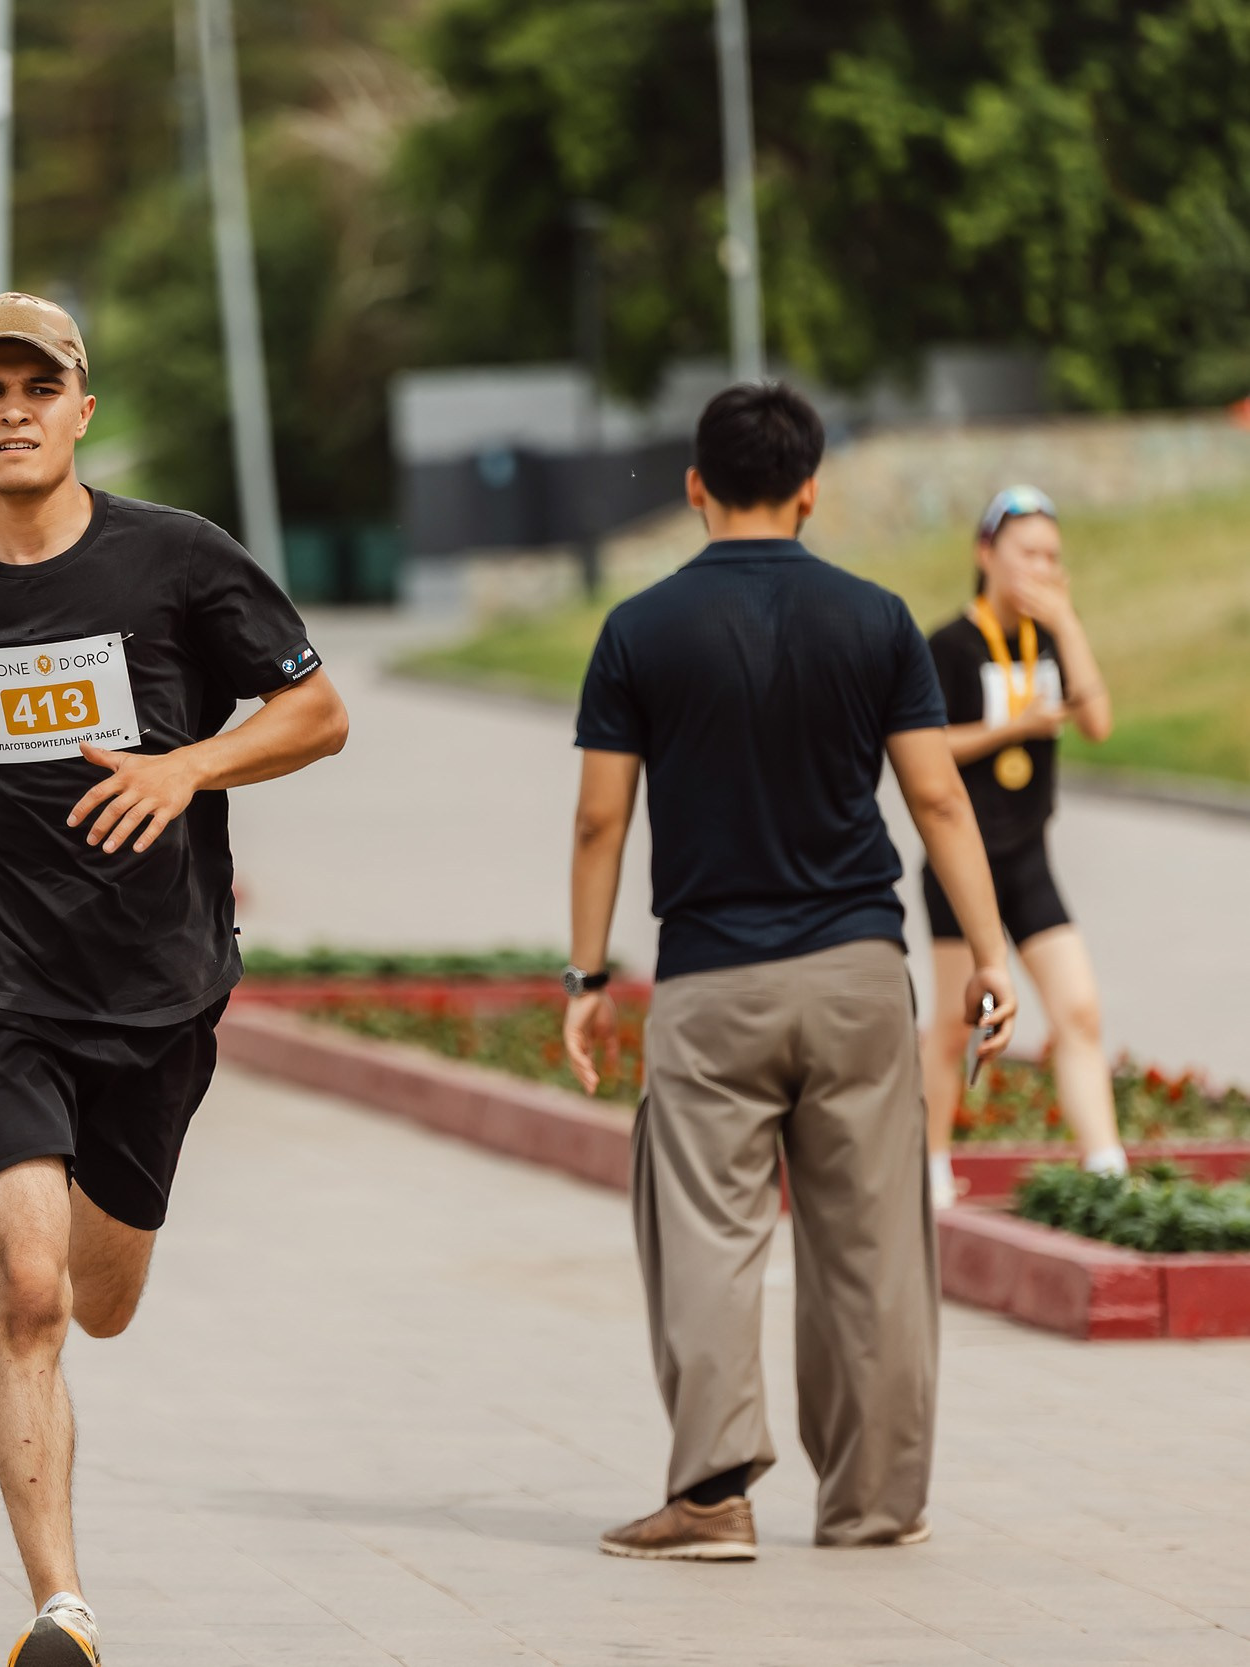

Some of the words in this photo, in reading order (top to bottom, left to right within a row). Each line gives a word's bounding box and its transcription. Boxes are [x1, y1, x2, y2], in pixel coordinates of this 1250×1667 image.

[59, 651, 109, 670] D'ORO
[12, 688, 88, 728] 413
[95, 728, 122, 741] ЗАБЕГ
